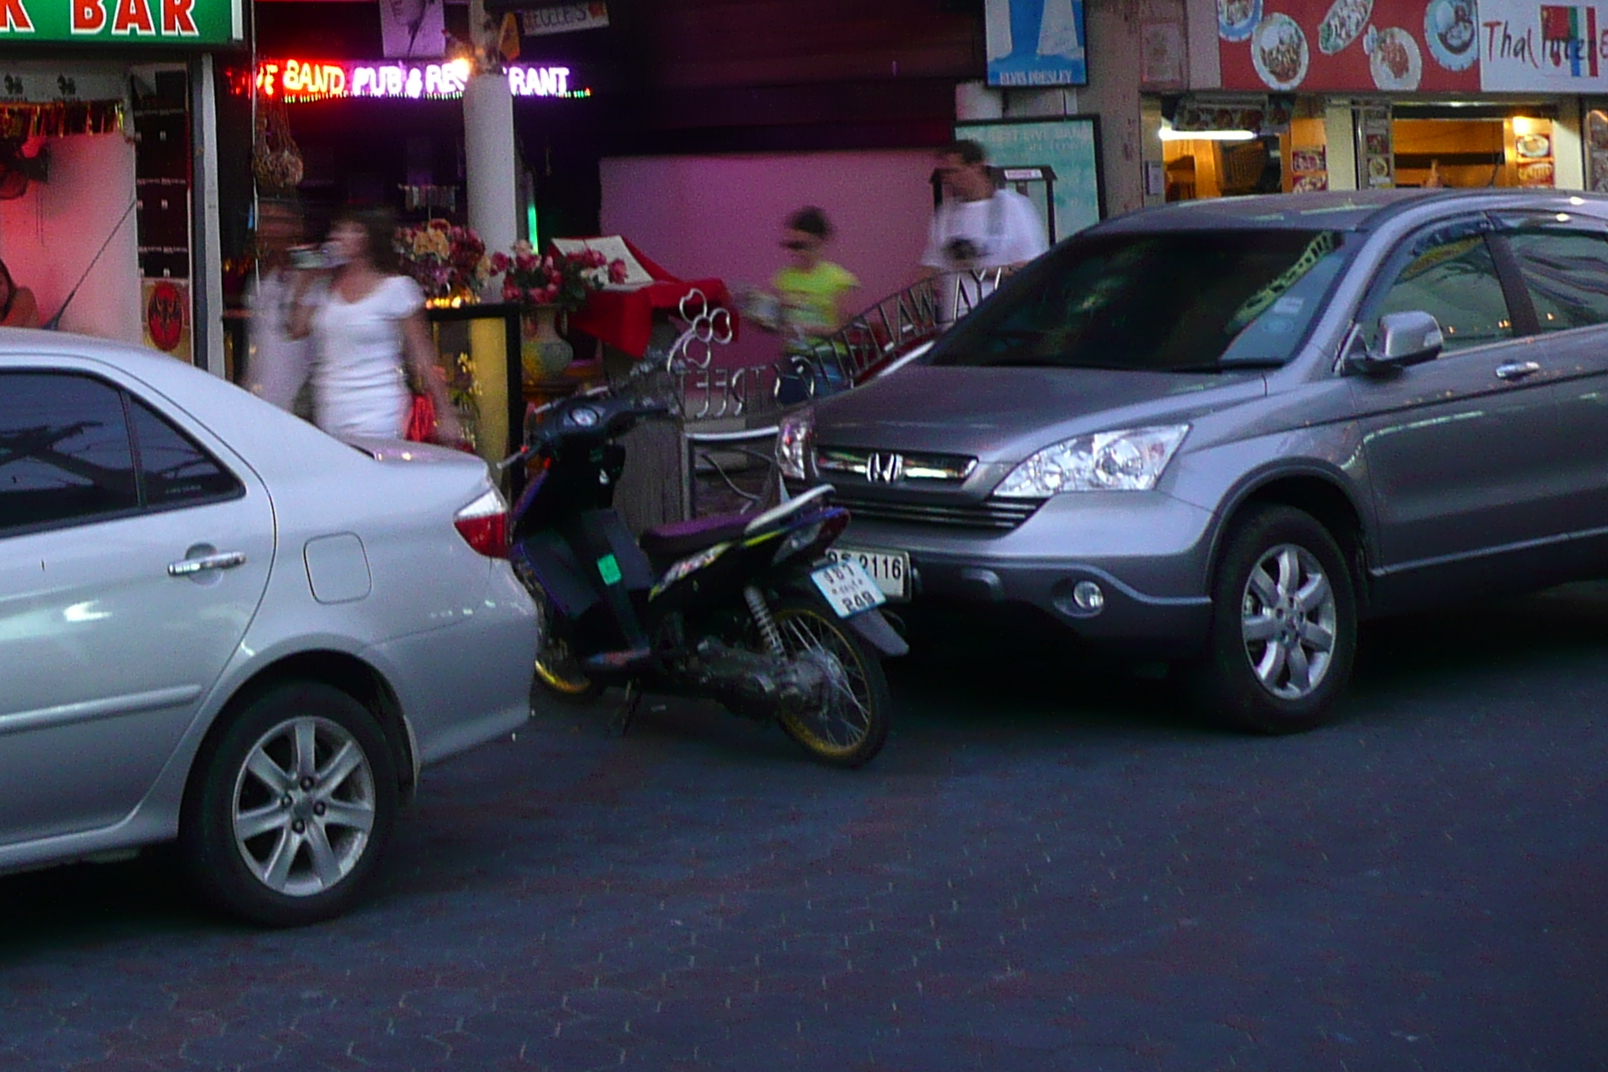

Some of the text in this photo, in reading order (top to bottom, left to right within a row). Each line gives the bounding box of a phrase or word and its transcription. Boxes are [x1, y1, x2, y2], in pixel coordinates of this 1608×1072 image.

[283, 59, 346, 96] BAND
[352, 65, 402, 96] PUB
[999, 69, 1072, 85] ELVIS PRESLEY
